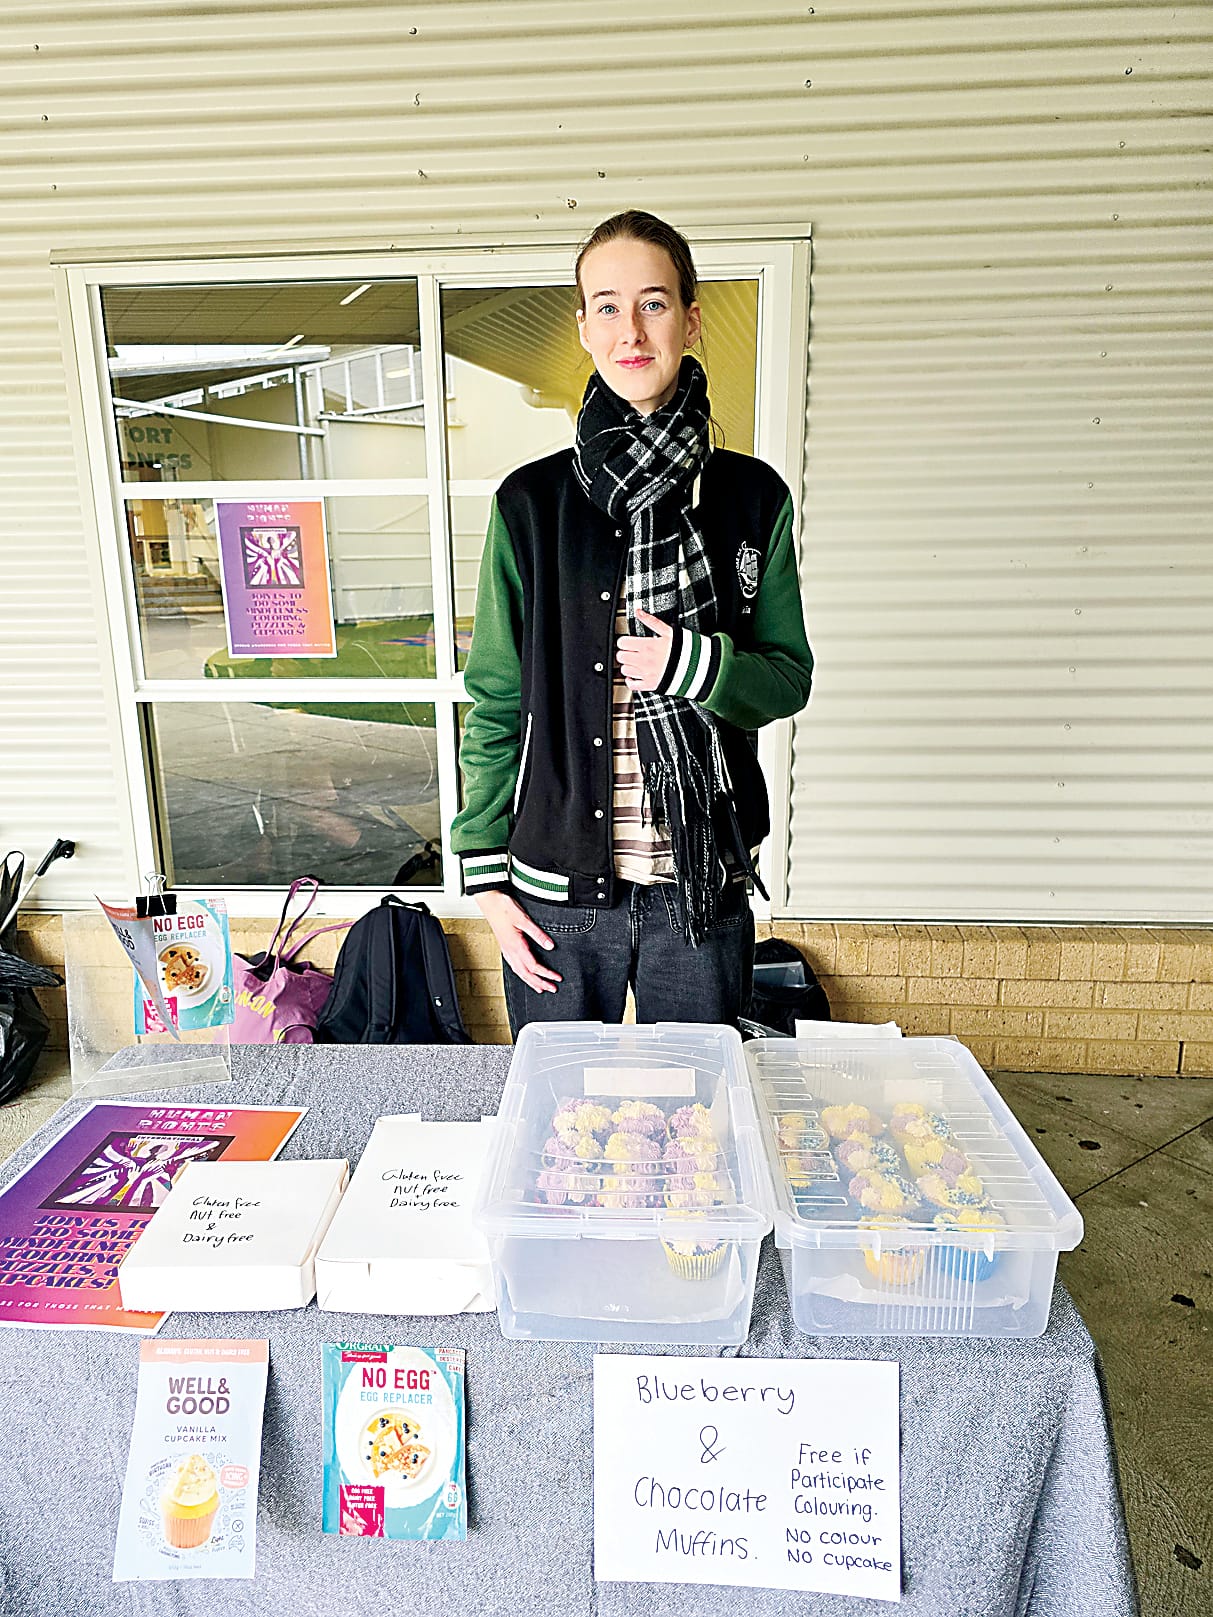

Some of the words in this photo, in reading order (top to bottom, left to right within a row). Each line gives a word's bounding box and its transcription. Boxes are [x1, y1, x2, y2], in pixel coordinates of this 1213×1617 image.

[154, 917, 173, 933] NO
[177, 914, 205, 930] EGG
[170, 930, 207, 940] REPLACER
[149, 1109, 233, 1120] HUMAN
[433, 1169, 464, 1182] free
[422, 1183, 448, 1195] free
[192, 1196, 230, 1208] Gluten
[235, 1197, 261, 1210] free
[34, 1215, 88, 1227] JOIN
[89, 1217, 119, 1228] US
[218, 1209, 242, 1220] free
[31, 1226, 71, 1238] DO
[75, 1229, 141, 1240] SOME
[0, 1236, 133, 1252] MINDFULNE
[362, 1367, 387, 1388] NO
[394, 1369, 430, 1391] EGG
[360, 1391, 379, 1402] EGG
[383, 1393, 433, 1405] REPLACER
[636, 1375, 795, 1415] Blueberry
[166, 1396, 231, 1415] GOOD
[176, 1425, 217, 1433] VANILLA
[164, 1435, 207, 1443] CUPCAKE
[210, 1435, 228, 1443] MIX
[699, 1425, 727, 1464] &
[798, 1443, 843, 1465] Free
[854, 1447, 872, 1466] if
[791, 1468, 887, 1494] Participate
[634, 1476, 767, 1513] Chocolate
[794, 1494, 878, 1523] Colouring.
[655, 1528, 758, 1560] Muffins.
[819, 1531, 882, 1546] colour
[823, 1553, 893, 1572] cupcake
